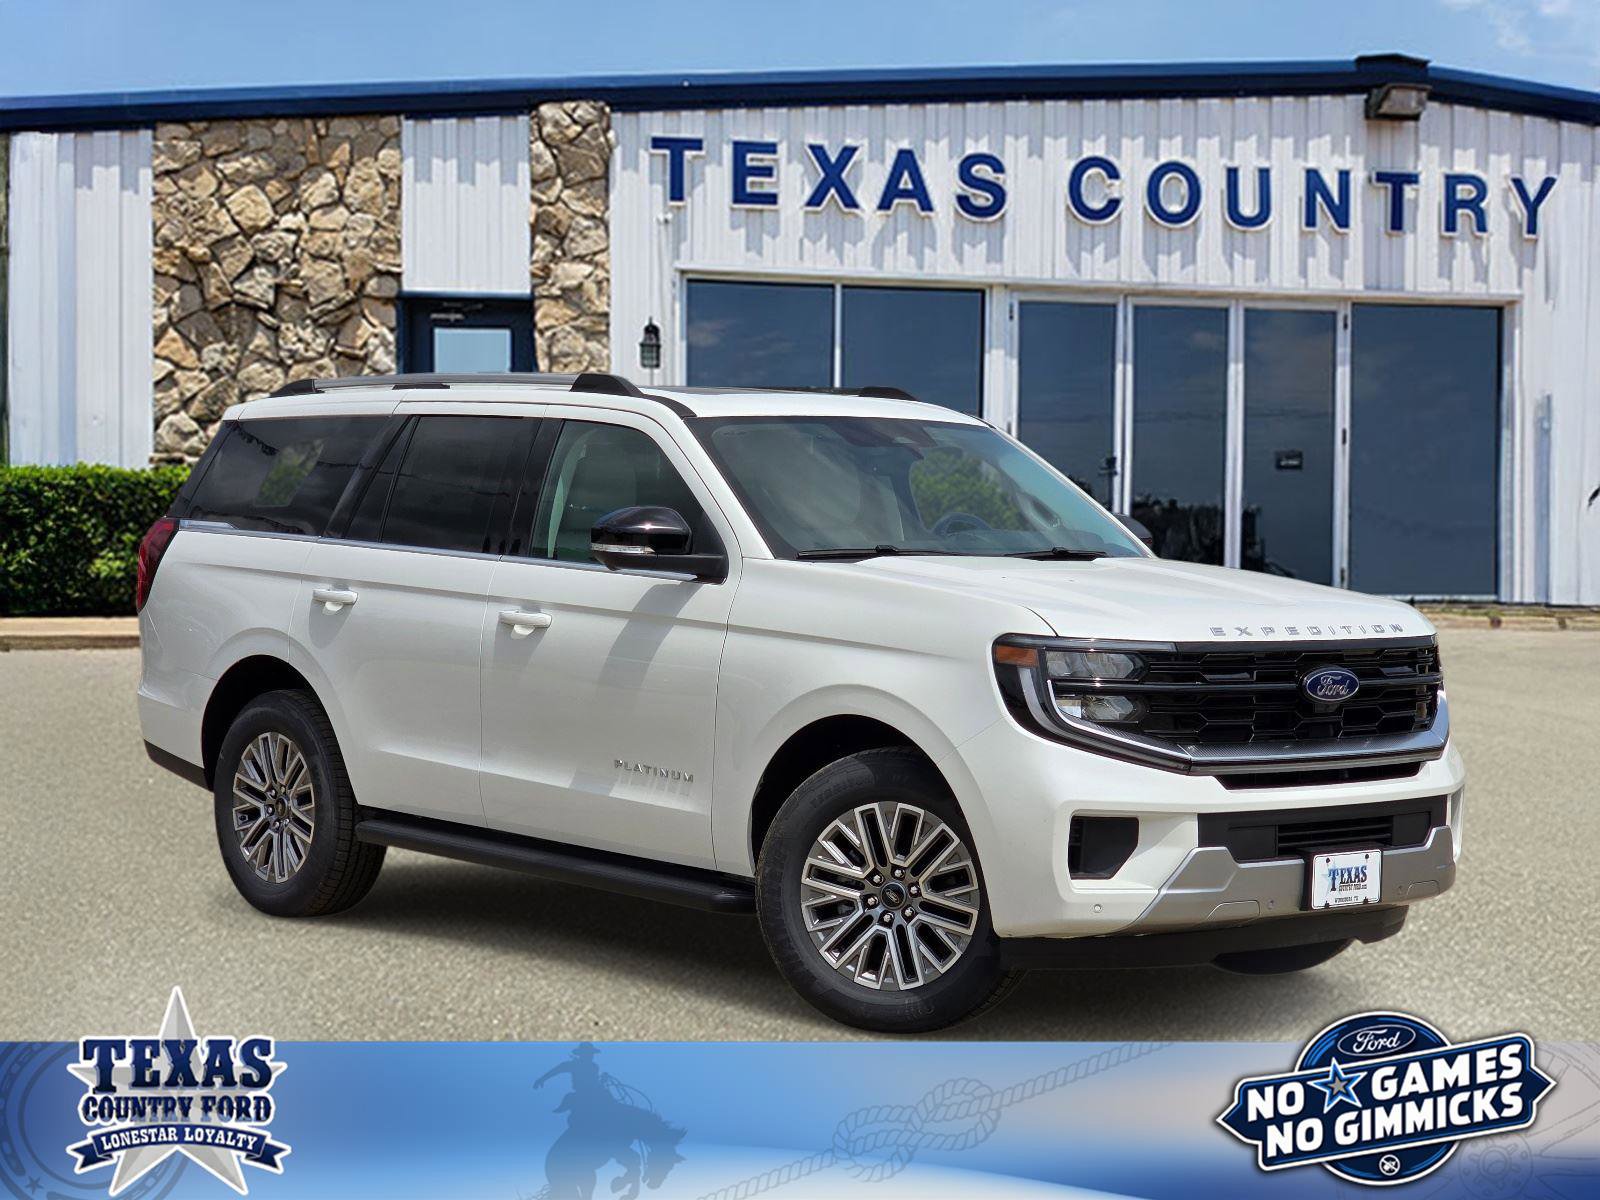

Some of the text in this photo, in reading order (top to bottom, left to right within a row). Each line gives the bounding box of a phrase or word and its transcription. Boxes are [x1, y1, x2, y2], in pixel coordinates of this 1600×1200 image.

[650, 135, 1560, 240] TEXAS COUNTRY
[1210, 625, 1404, 637] EXPEDITION
[1316, 675, 1350, 696] Ford
[614, 758, 694, 783] PLATINUM
[1328, 865, 1368, 892] TEXAS
